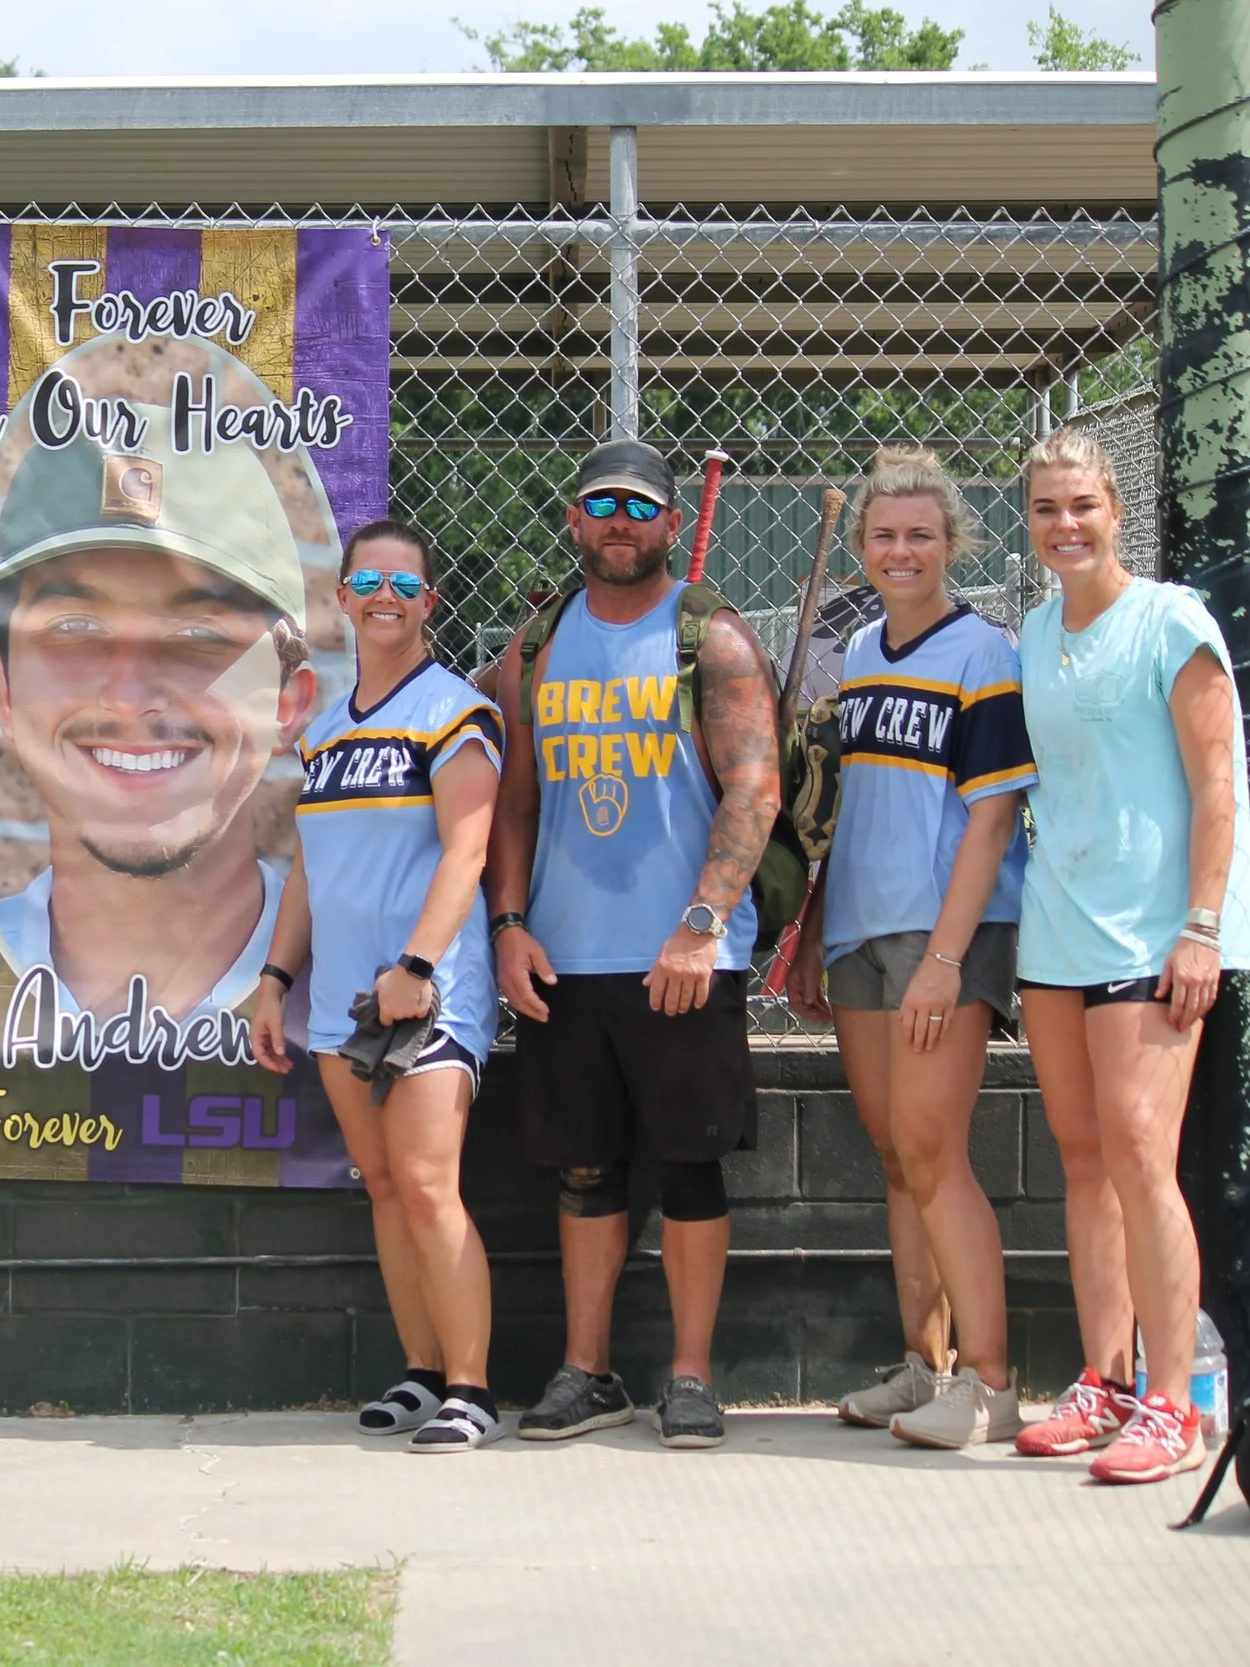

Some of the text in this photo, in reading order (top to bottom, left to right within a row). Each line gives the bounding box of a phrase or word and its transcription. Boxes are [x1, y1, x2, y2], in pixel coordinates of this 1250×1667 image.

[48, 258, 256, 346] Forever
[30, 367, 151, 451] Our
[172, 371, 353, 456] Hearts
[537, 673, 679, 728] BREW
[875, 696, 953, 753] CREW
[340, 746, 411, 790] CREW
[541, 732, 678, 782] CREW
[141, 1094, 297, 1150] LSU
